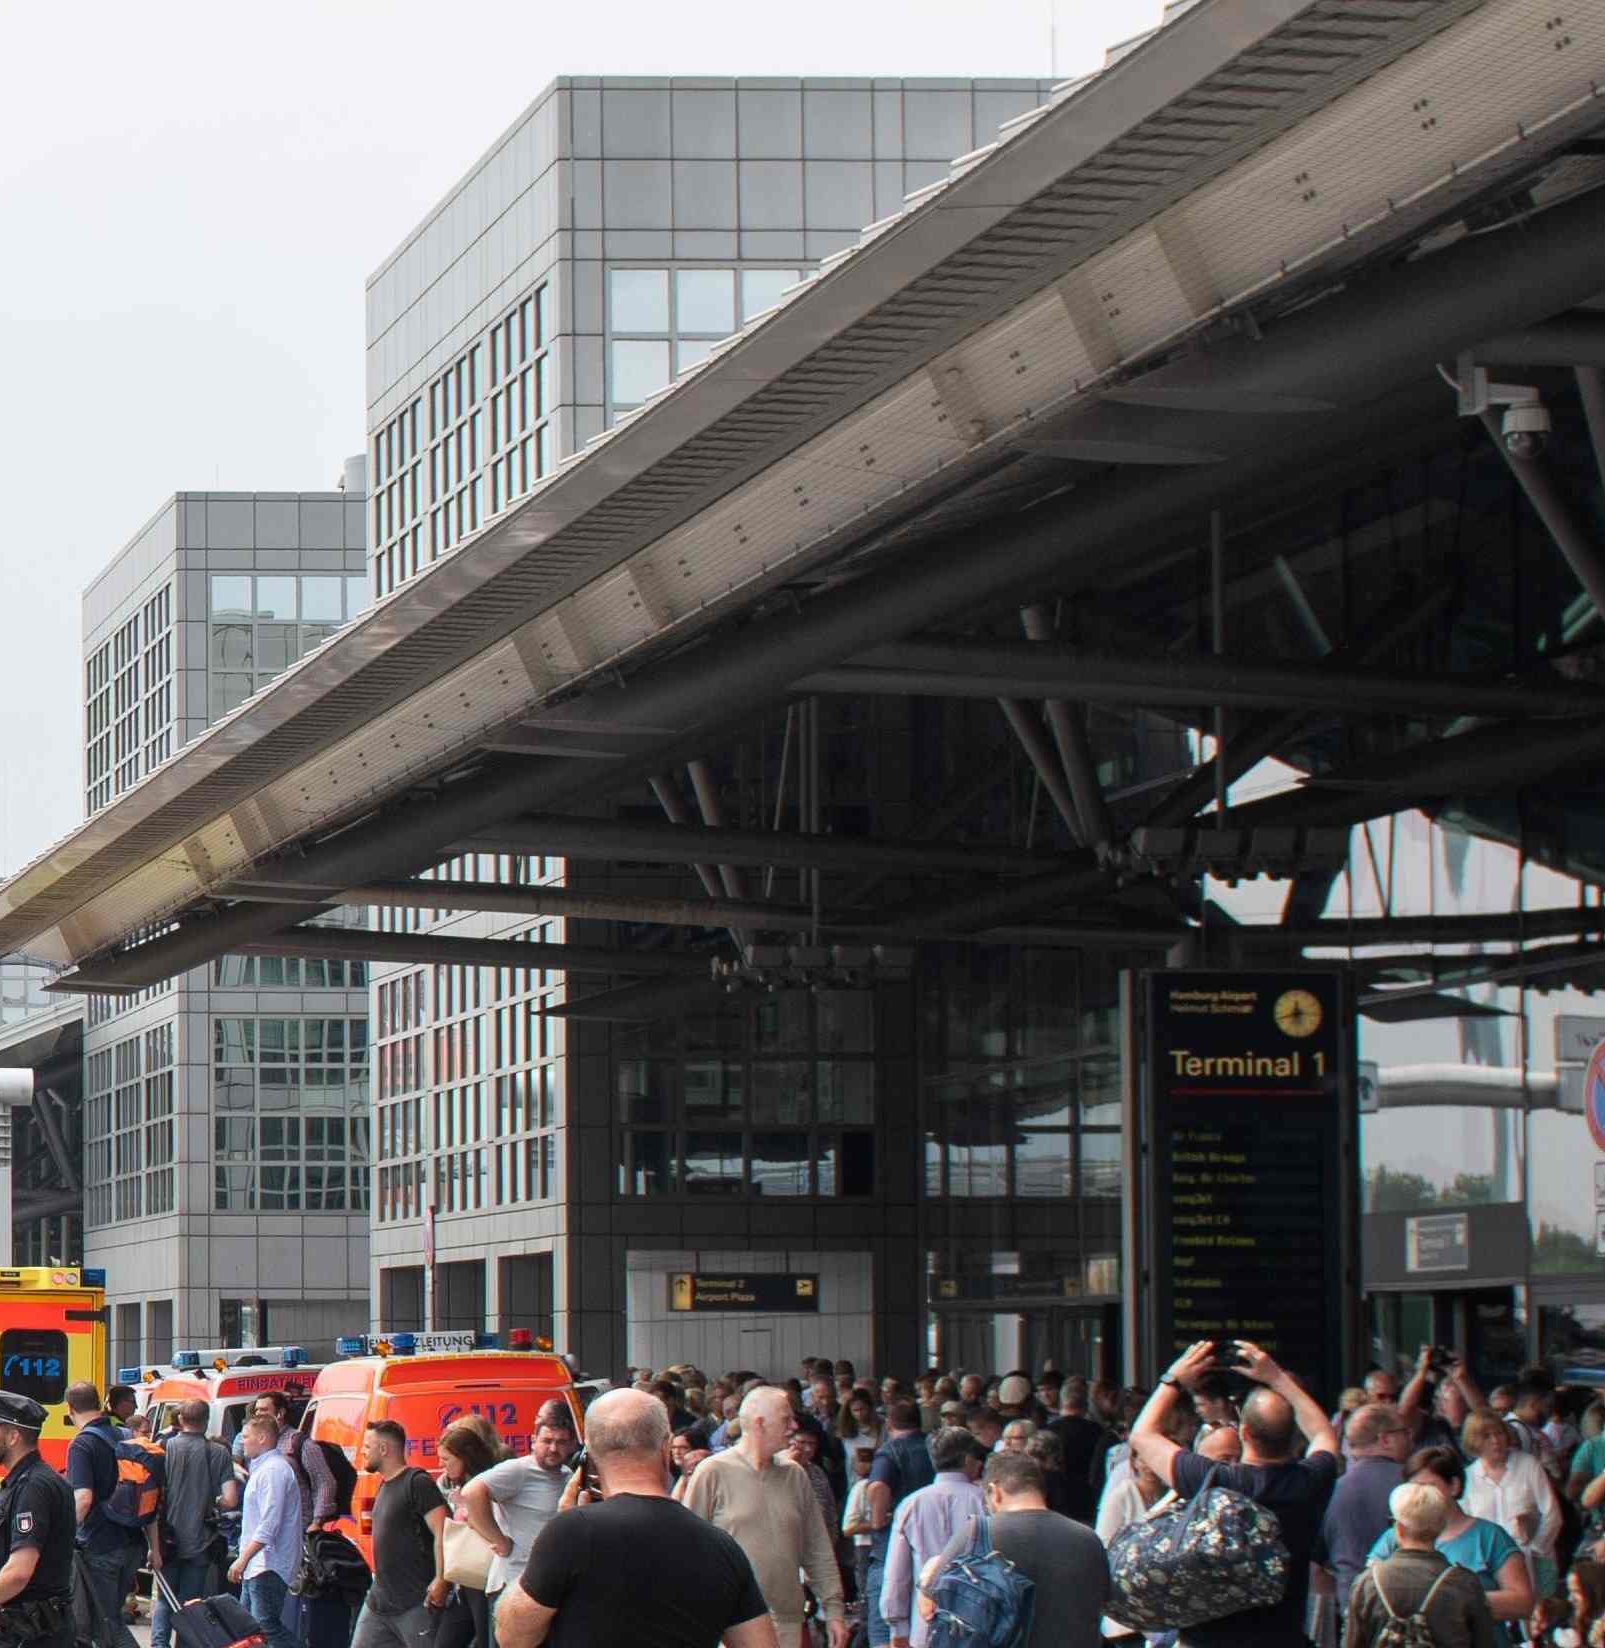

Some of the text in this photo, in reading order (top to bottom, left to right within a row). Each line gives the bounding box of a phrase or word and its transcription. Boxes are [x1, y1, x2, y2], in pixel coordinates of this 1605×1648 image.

[1169, 1050, 1325, 1077] Terminal 1
[19, 1358, 60, 1377] 112
